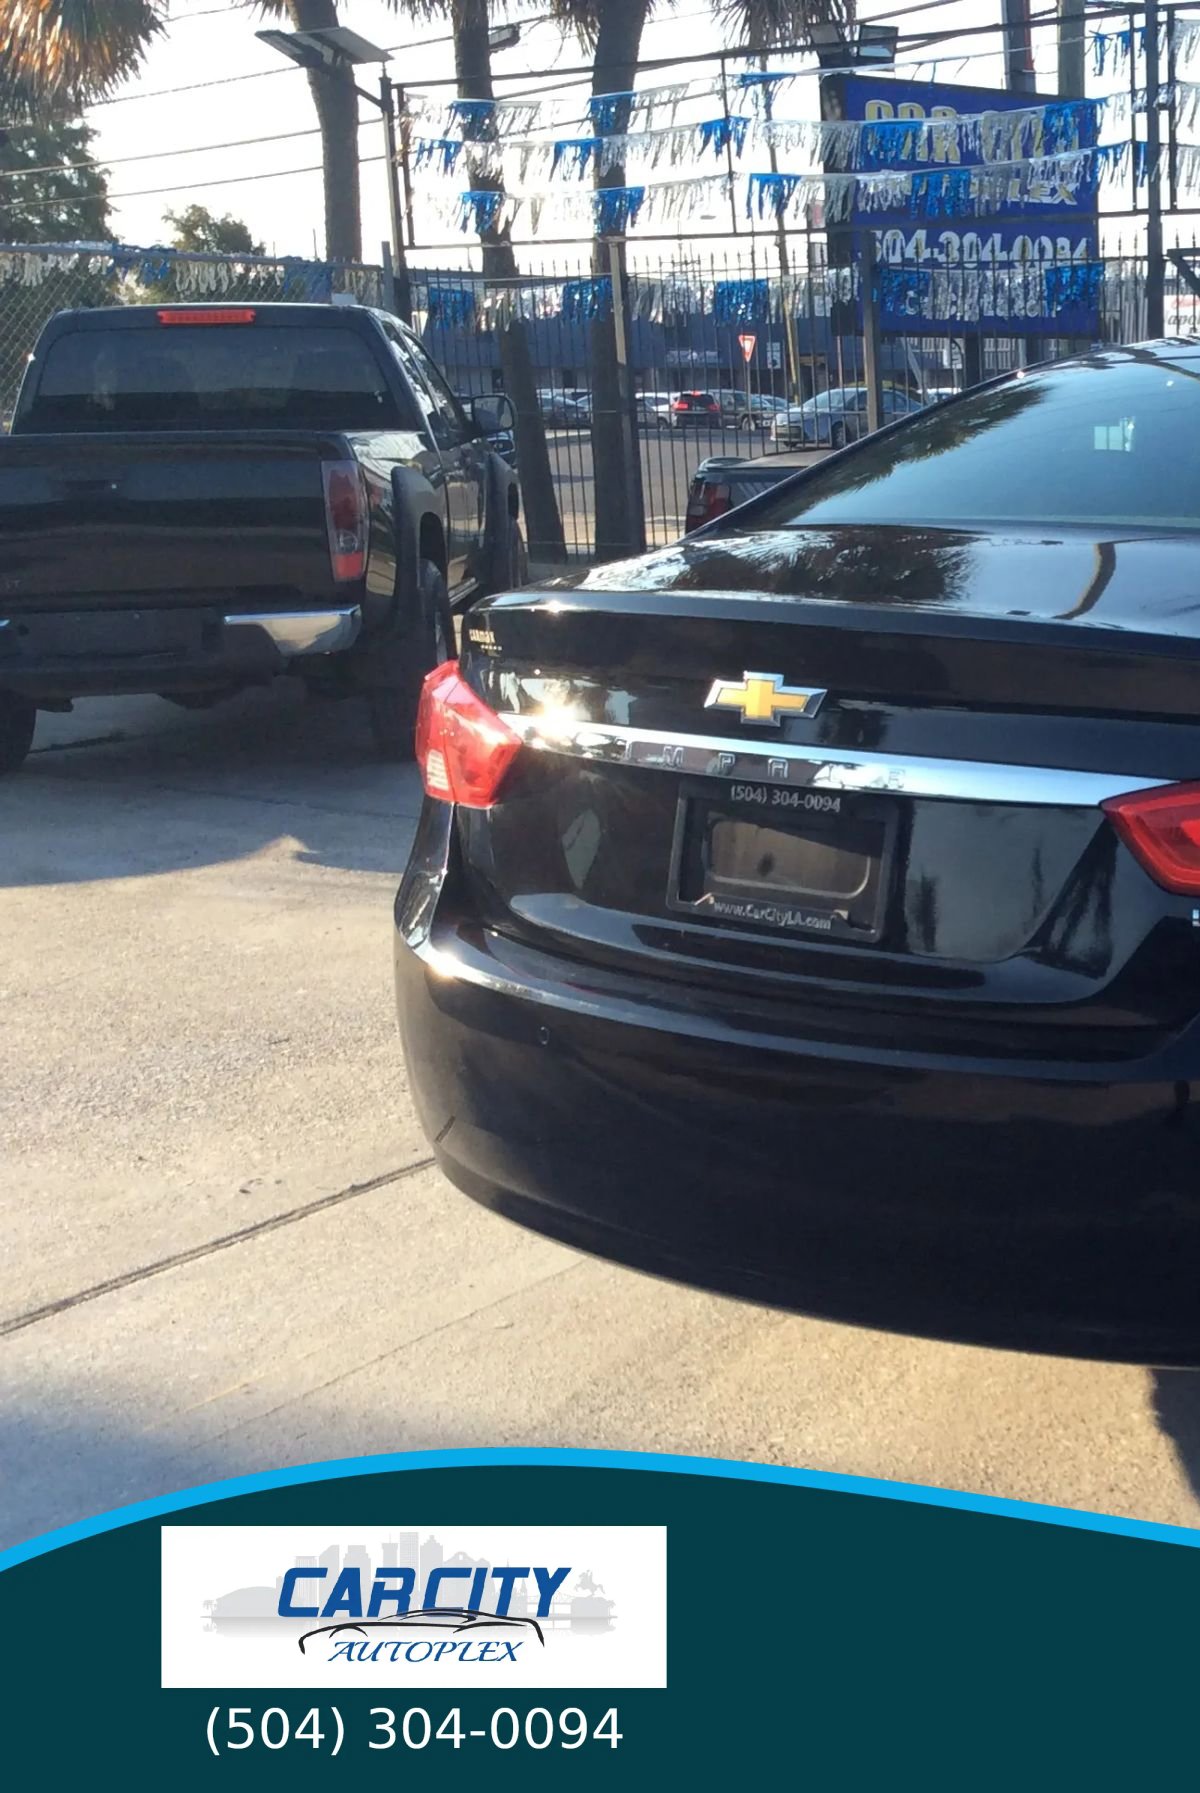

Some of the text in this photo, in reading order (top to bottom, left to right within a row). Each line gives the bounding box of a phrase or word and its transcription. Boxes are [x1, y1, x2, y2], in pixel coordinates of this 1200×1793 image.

[730, 785, 842, 813] (504) 304-0094
[713, 900, 832, 931] www.CarCityLA.com
